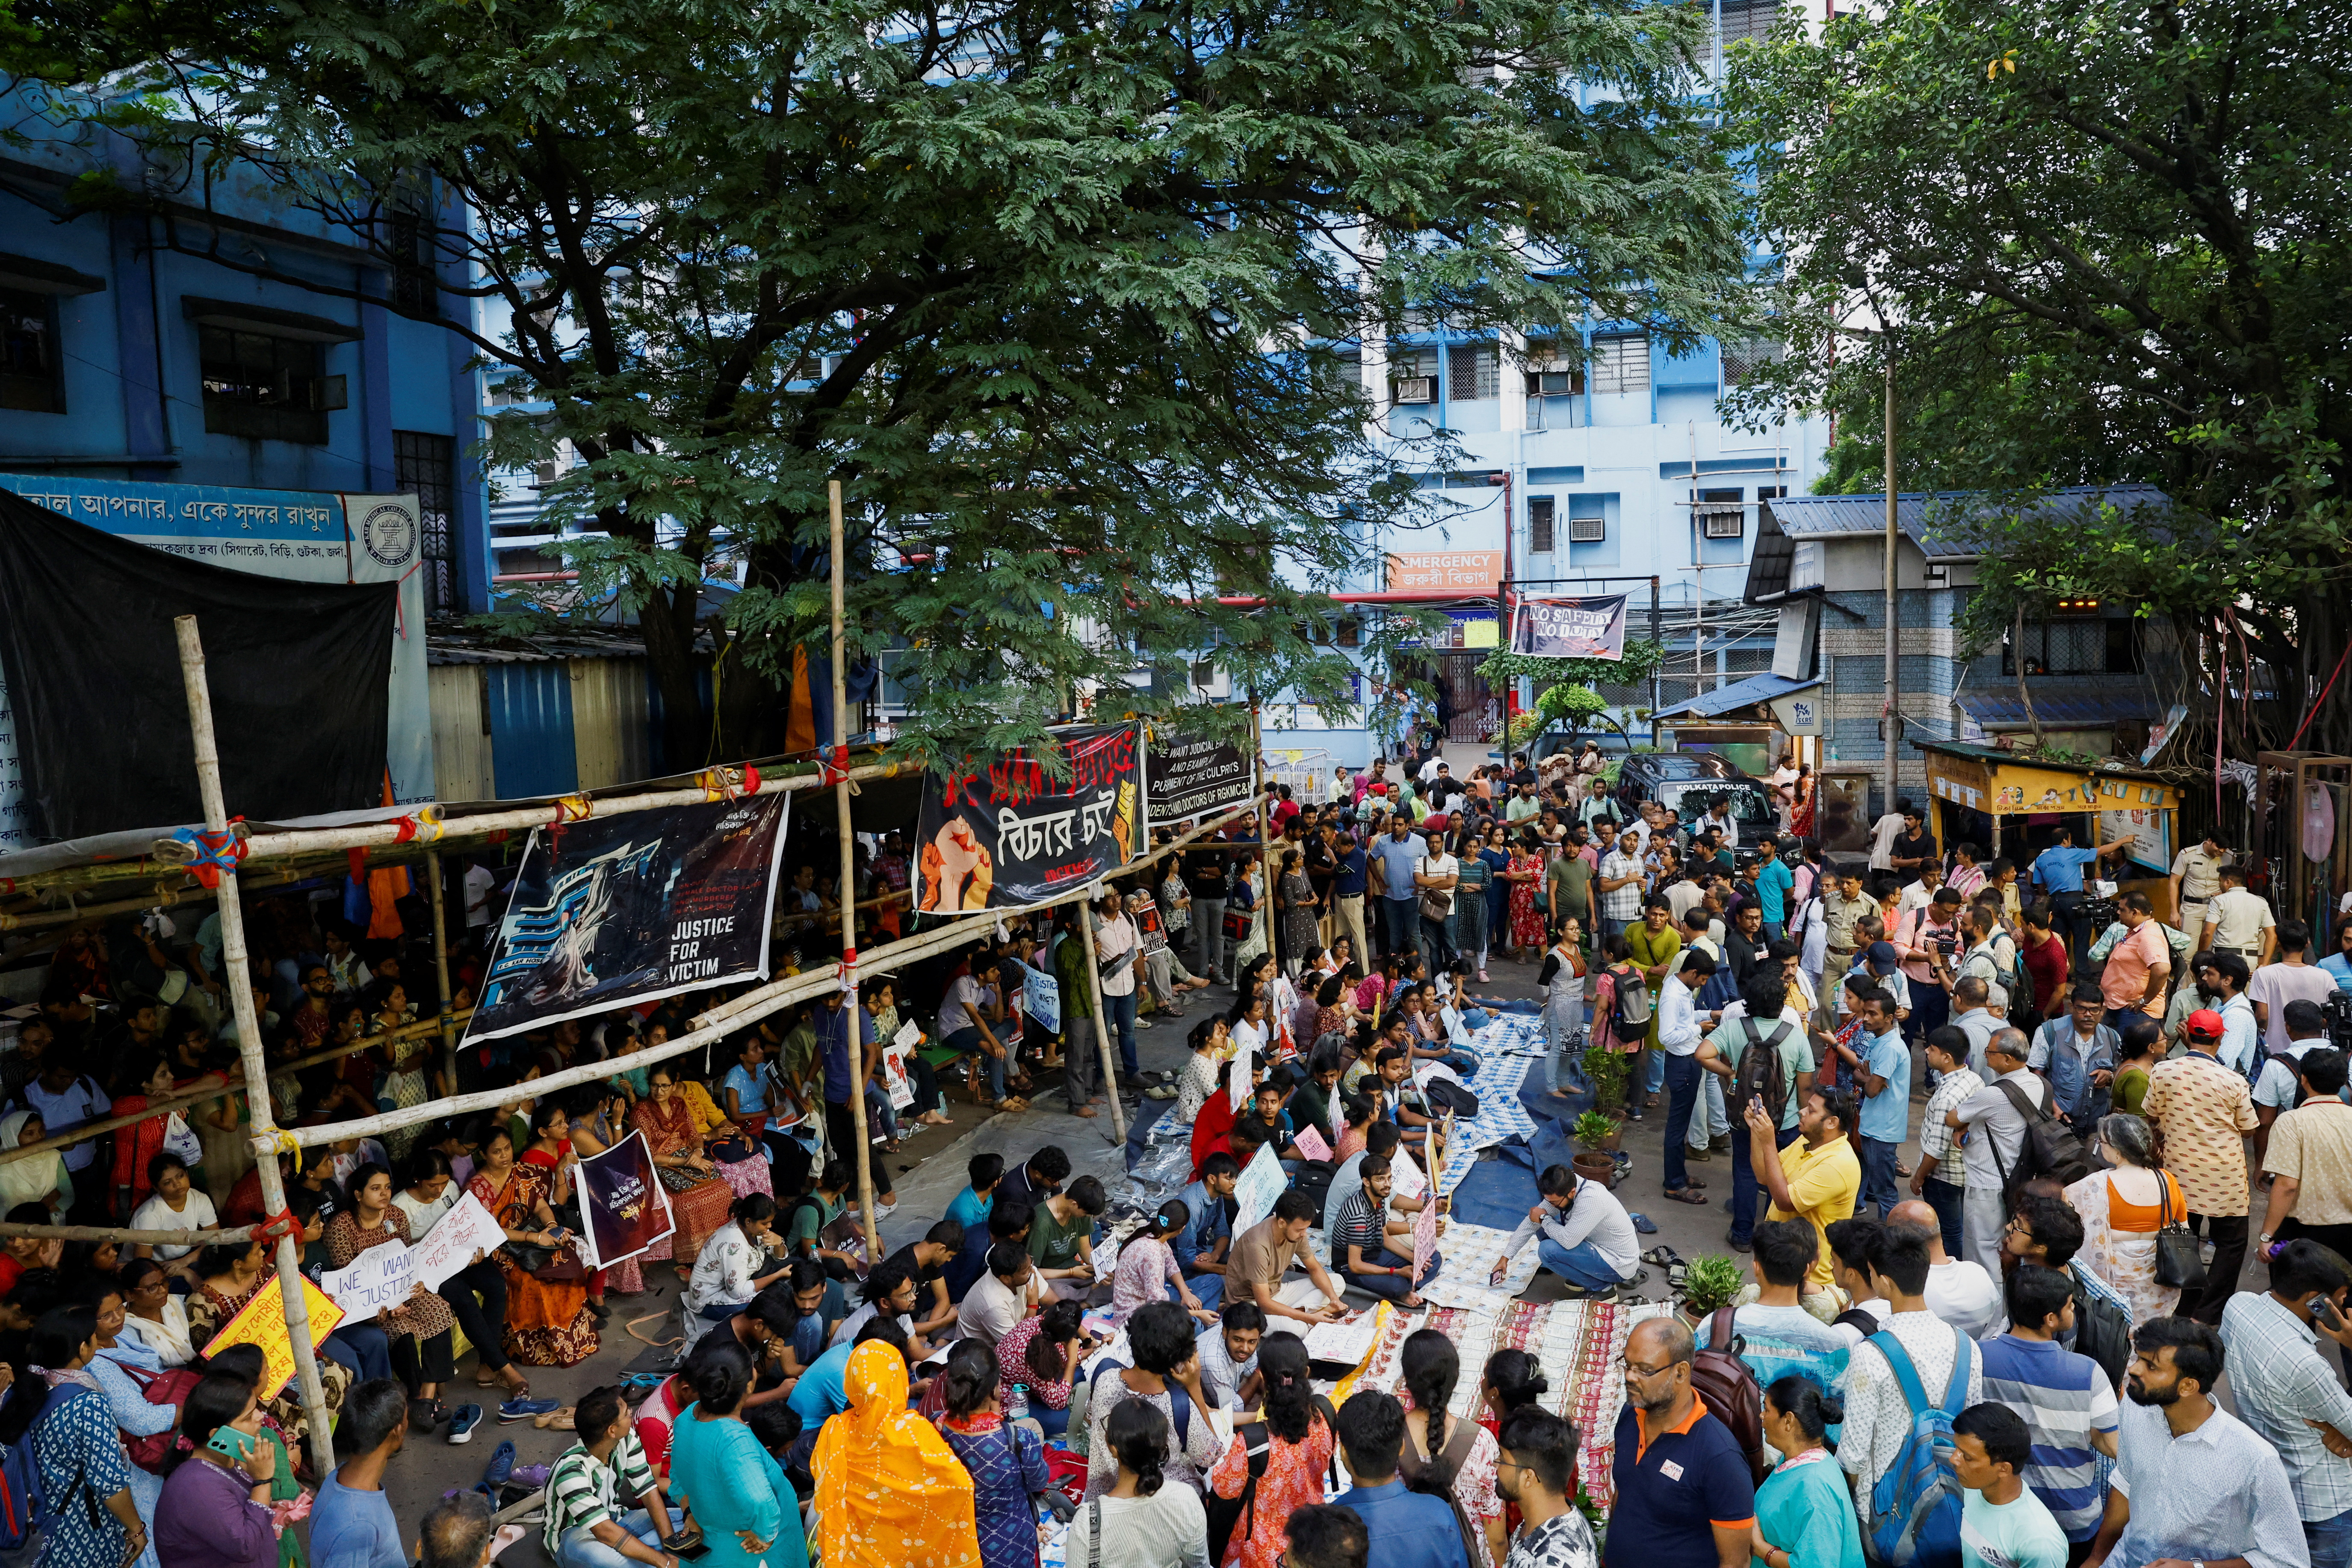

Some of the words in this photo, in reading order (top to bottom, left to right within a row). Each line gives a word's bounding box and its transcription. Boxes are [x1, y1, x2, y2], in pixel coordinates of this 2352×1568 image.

[79, 494, 174, 522] আপনার,
[181, 502, 228, 522] একে
[231, 504, 279, 530] সুন্দর
[284, 505, 330, 533] রাখুন
[366, 507, 387, 525] MEDICAL
[387, 506, 410, 521] COLLEGE
[407, 526, 416, 556] HOSPITAL
[376, 555, 408, 564] KOLKATA
[1401, 555, 1491, 569] EMERGENCY
[1447, 568, 1489, 585] বিভাগ
[1530, 605, 1550, 621] NO
[1553, 609, 1613, 626] SAFETY
[1537, 621, 1557, 637] NO
[1559, 623, 1605, 639] DUTY
[1169, 745, 1189, 759] WANT
[1189, 740, 1214, 756] JUDICIAL
[1168, 762, 1187, 773] AND
[1187, 774, 1197, 785] OF
[1197, 770, 1206, 782] THE
[1206, 761, 1239, 779] CULPRITS
[1173, 800, 1182, 815] AND
[1183, 794, 1208, 811] DOCTORS
[1208, 790, 1218, 803] OF
[998, 807, 1076, 867] বিচার
[1082, 788, 1116, 846] চাই
[671, 915, 735, 940] JUSTICE
[1141, 929, 1163, 943] HURTING
[670, 941, 700, 962] FOR
[1142, 939, 1165, 953] HEALERS
[669, 957, 719, 983] VICTIM
[1034, 975, 1058, 989] JUSTICE
[897, 1031, 906, 1042] WE
[905, 1019, 913, 1032] WANT
[902, 1027, 918, 1047] JUSTICE
[889, 1077, 896, 1085] We
[890, 1085, 903, 1096] Want
[893, 1093, 911, 1106] Justice.
[1307, 1140, 1322, 1155] JUSTICE
[1237, 1167, 1256, 1191] JUSTICE
[1256, 1145, 1272, 1170] DELAYED
[1259, 1187, 1276, 1212] DENIED
[620, 1205, 640, 1220] বিচার
[425, 1244, 449, 1268] পরে
[1094, 1249, 1102, 1261] NO
[1102, 1237, 1116, 1253] MERCY
[339, 1270, 362, 1294] WE
[382, 1247, 418, 1277] WANT
[1097, 1261, 1106, 1274] TO
[359, 1270, 415, 1308] JUSTICE
[1323, 1327, 1349, 1349] PROPER
[1670, 1464, 1681, 1473] XTRA
[1980, 1548, 2002, 1566] adidas
